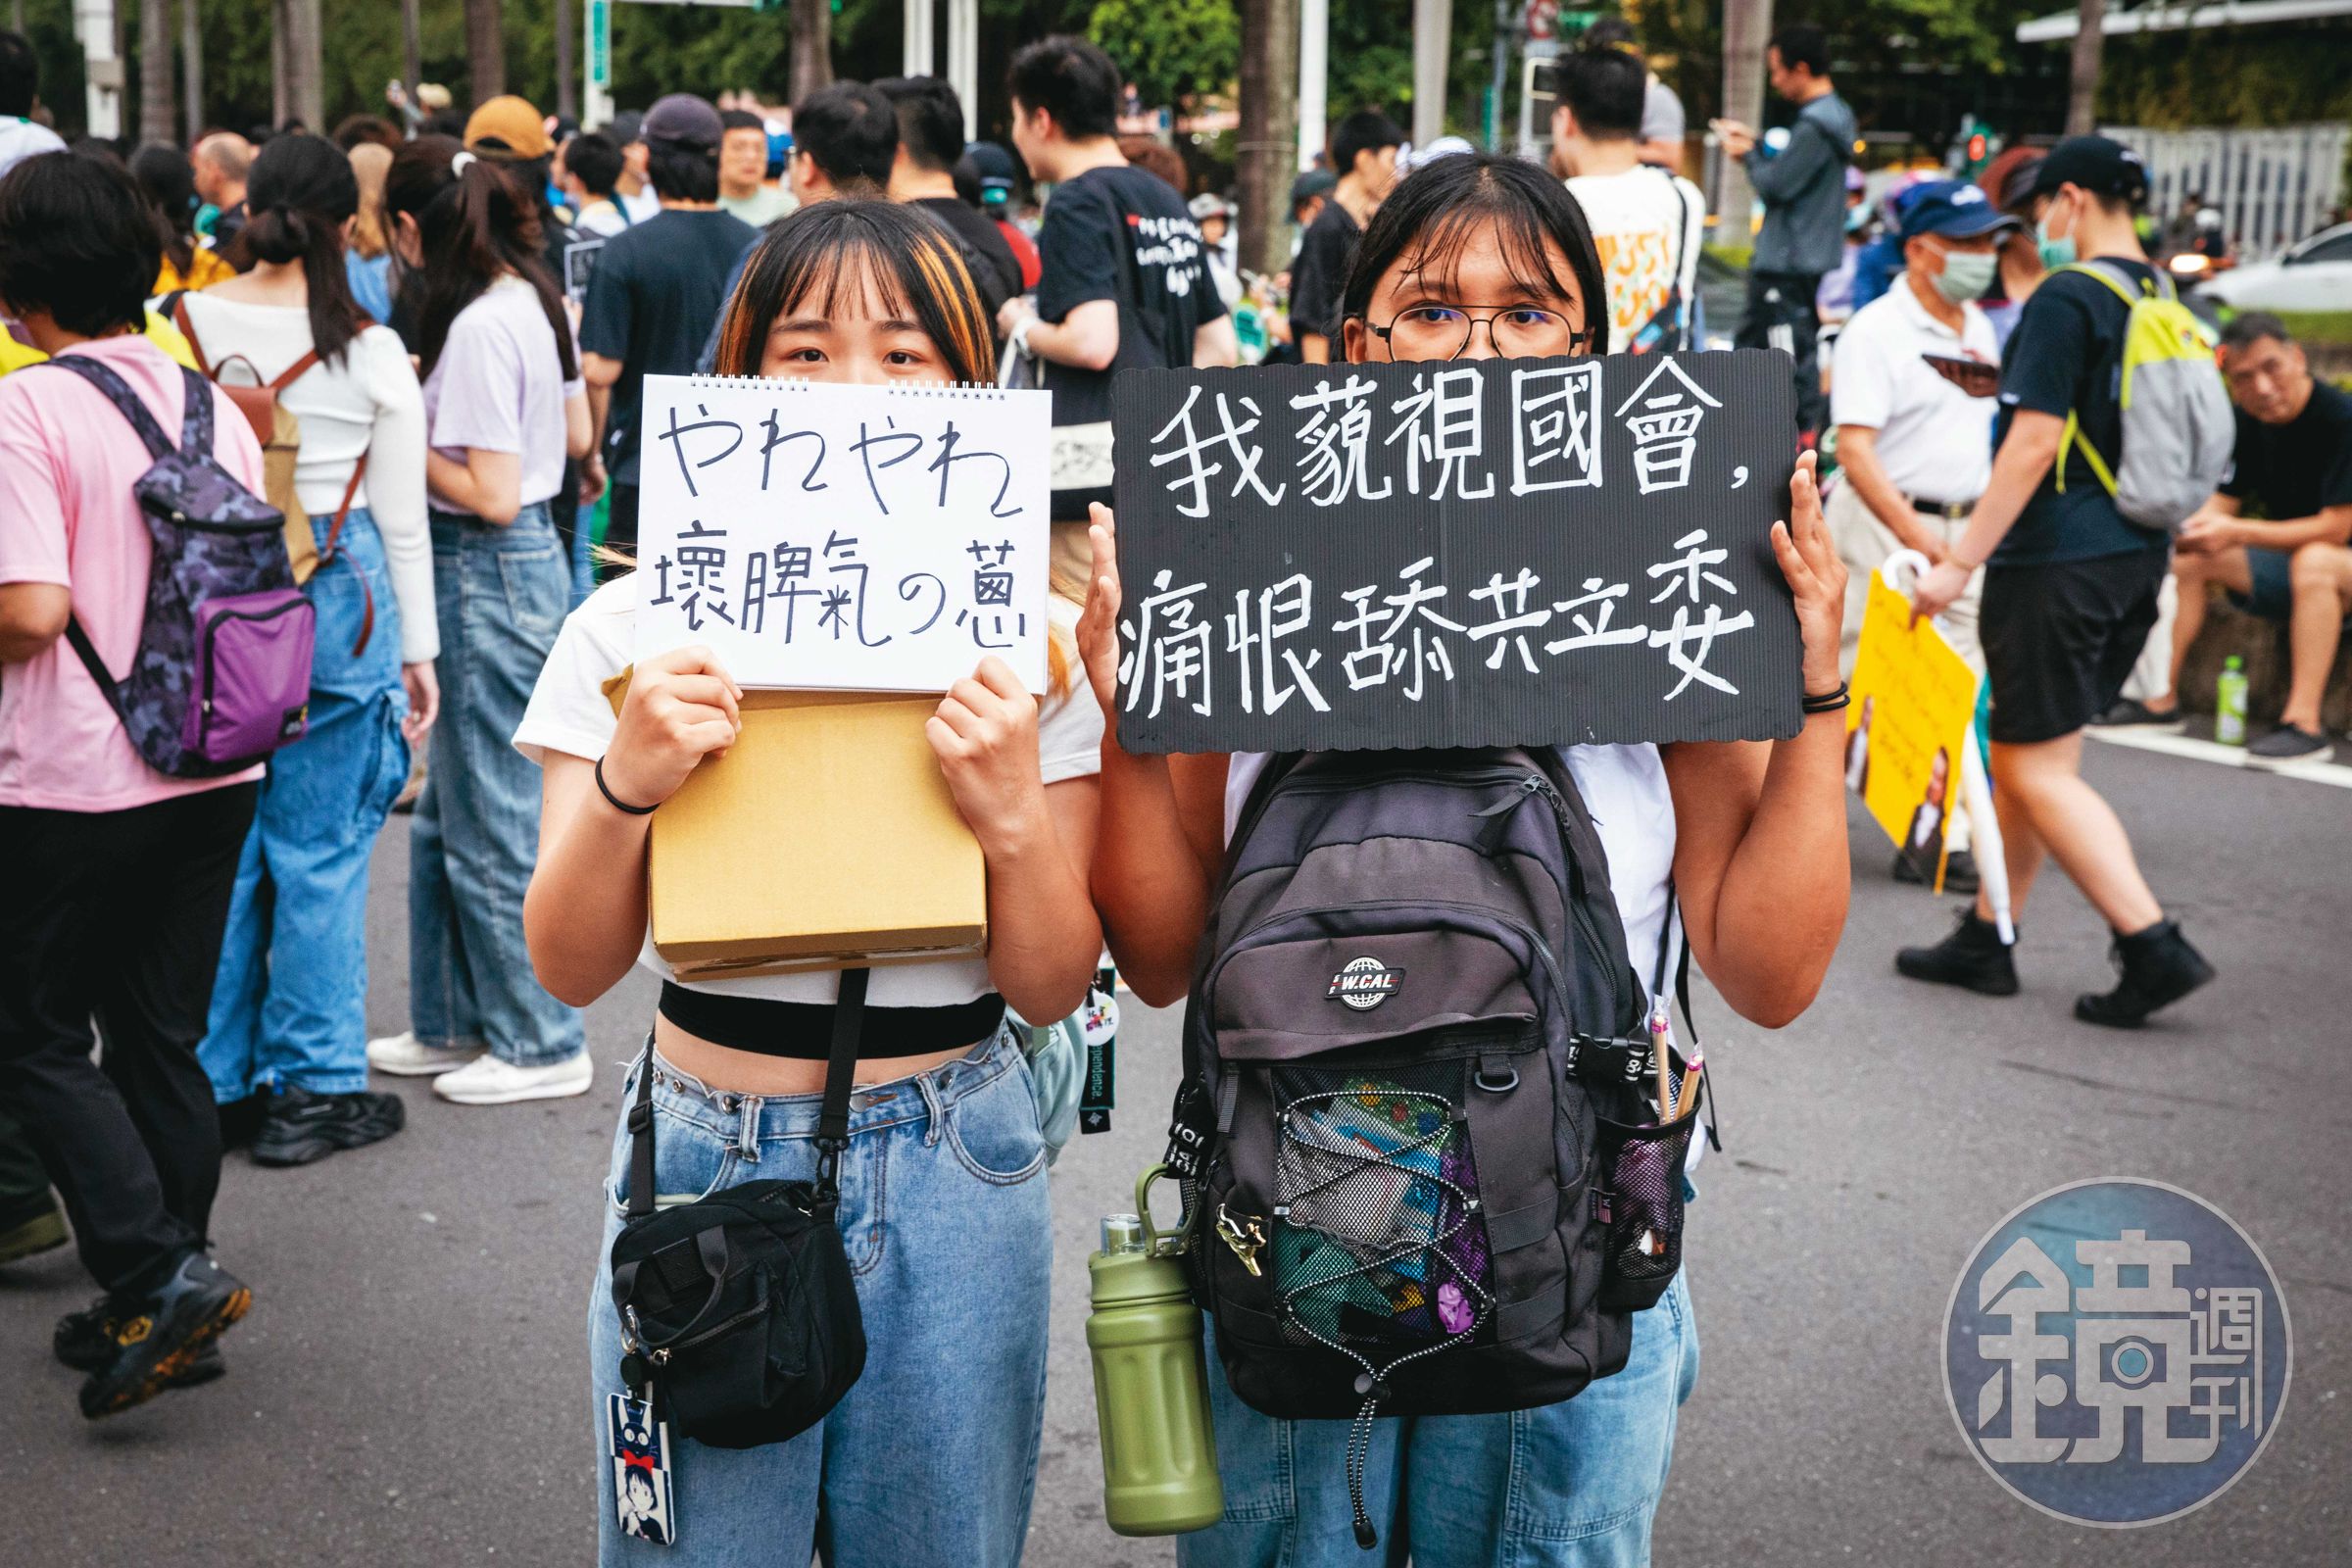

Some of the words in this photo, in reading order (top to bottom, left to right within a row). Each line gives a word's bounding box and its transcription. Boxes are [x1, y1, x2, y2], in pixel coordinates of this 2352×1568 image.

[658, 403, 1023, 517] やれやれ
[1117, 529, 1754, 719] 痛恨舔共立委
[1342, 973, 1393, 991] W.CAL
